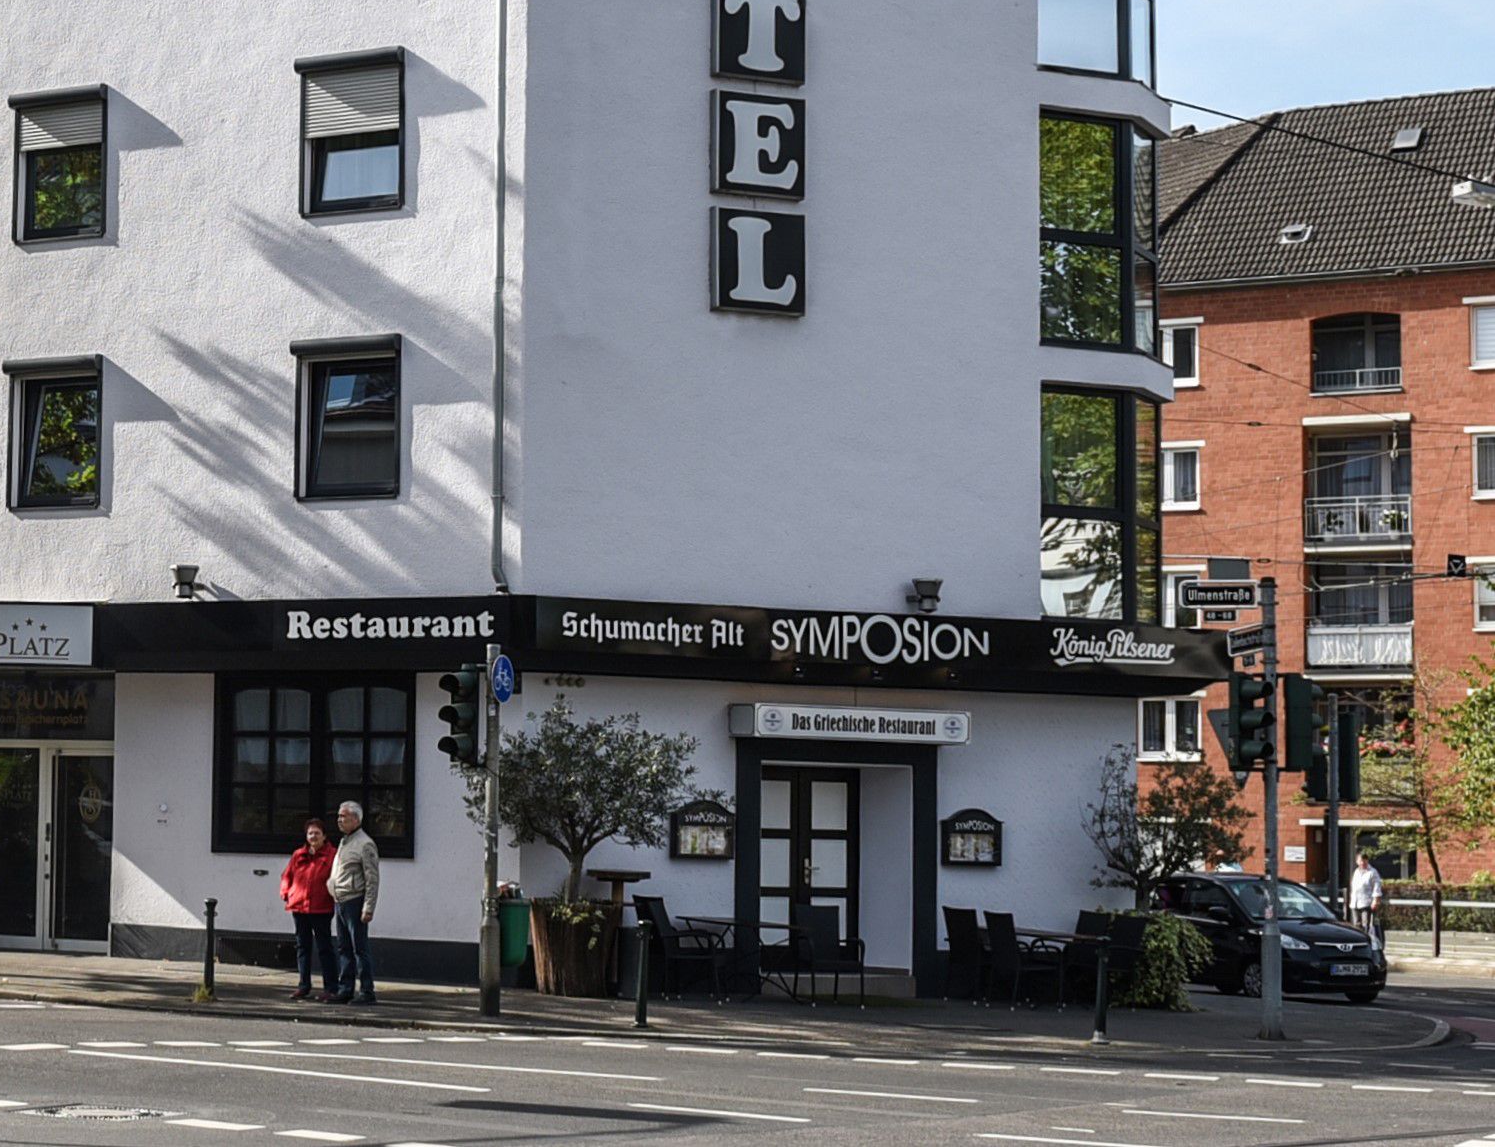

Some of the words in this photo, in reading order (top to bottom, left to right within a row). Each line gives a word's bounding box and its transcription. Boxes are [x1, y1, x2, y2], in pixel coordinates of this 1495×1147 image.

[1187, 588, 1251, 602] Ulmenstraße
[286, 610, 495, 639] Restaurant
[561, 611, 704, 647] Schumacher
[710, 618, 745, 649] Alt
[770, 614, 990, 665] SYMPOSION
[1050, 628, 1106, 663] König
[1105, 629, 1176, 659] Pilsener
[791, 713, 812, 731] Das
[813, 713, 876, 733] Griechische
[878, 716, 937, 735] Restaurant
[954, 819, 995, 831] SYMPOSION
